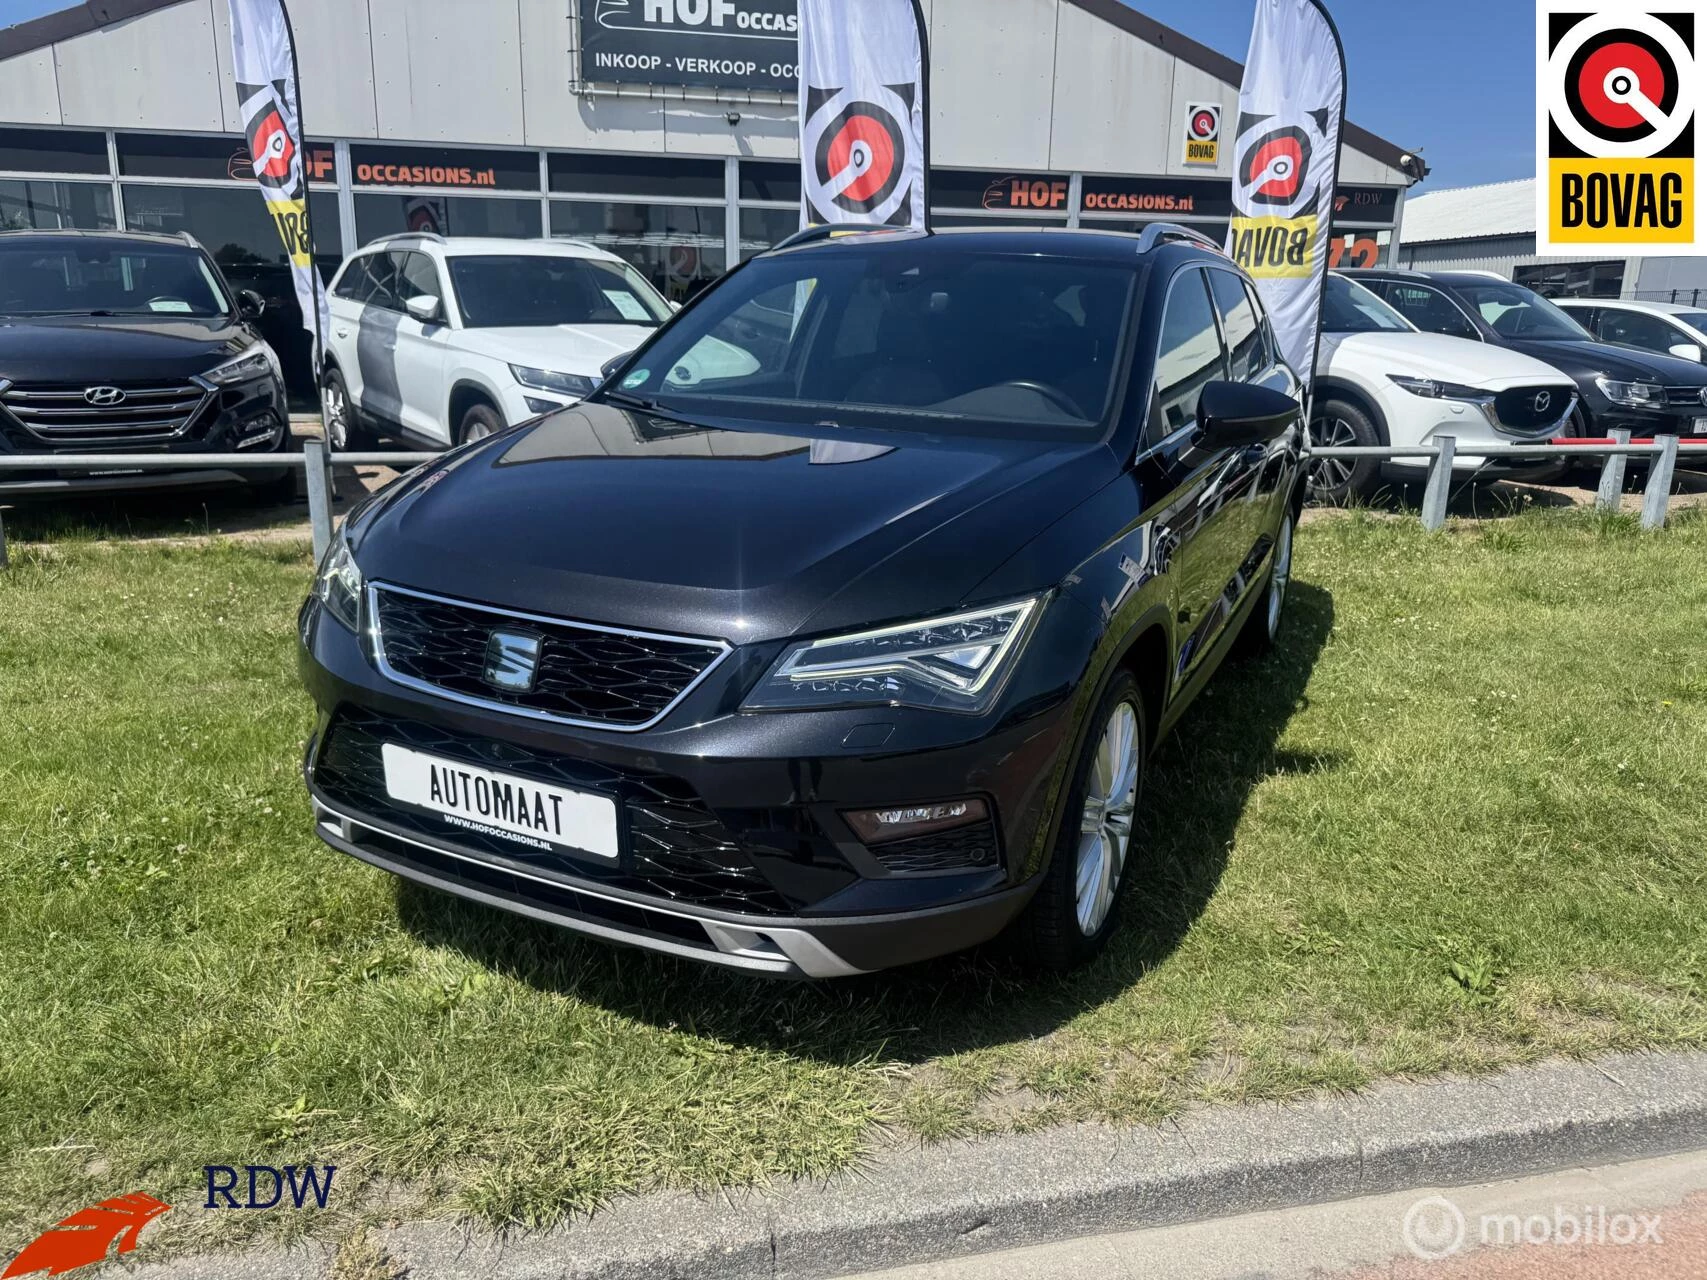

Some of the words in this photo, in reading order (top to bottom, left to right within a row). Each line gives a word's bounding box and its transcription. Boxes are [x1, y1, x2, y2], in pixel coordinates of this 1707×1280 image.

[595, 53, 661, 70] INKOOP
[675, 57, 756, 76] VERKOOP
[1188, 144, 1214, 159] BOVAG
[357, 164, 496, 185] OCCASIONS.nl
[1010, 180, 1067, 208] HOF
[1085, 193, 1193, 211] OCCASIONS.nl
[1354, 192, 1382, 205] RDW
[430, 763, 563, 836] AUTOMAAT
[443, 813, 553, 851] WWW.HOFOCCASIONS.NL
